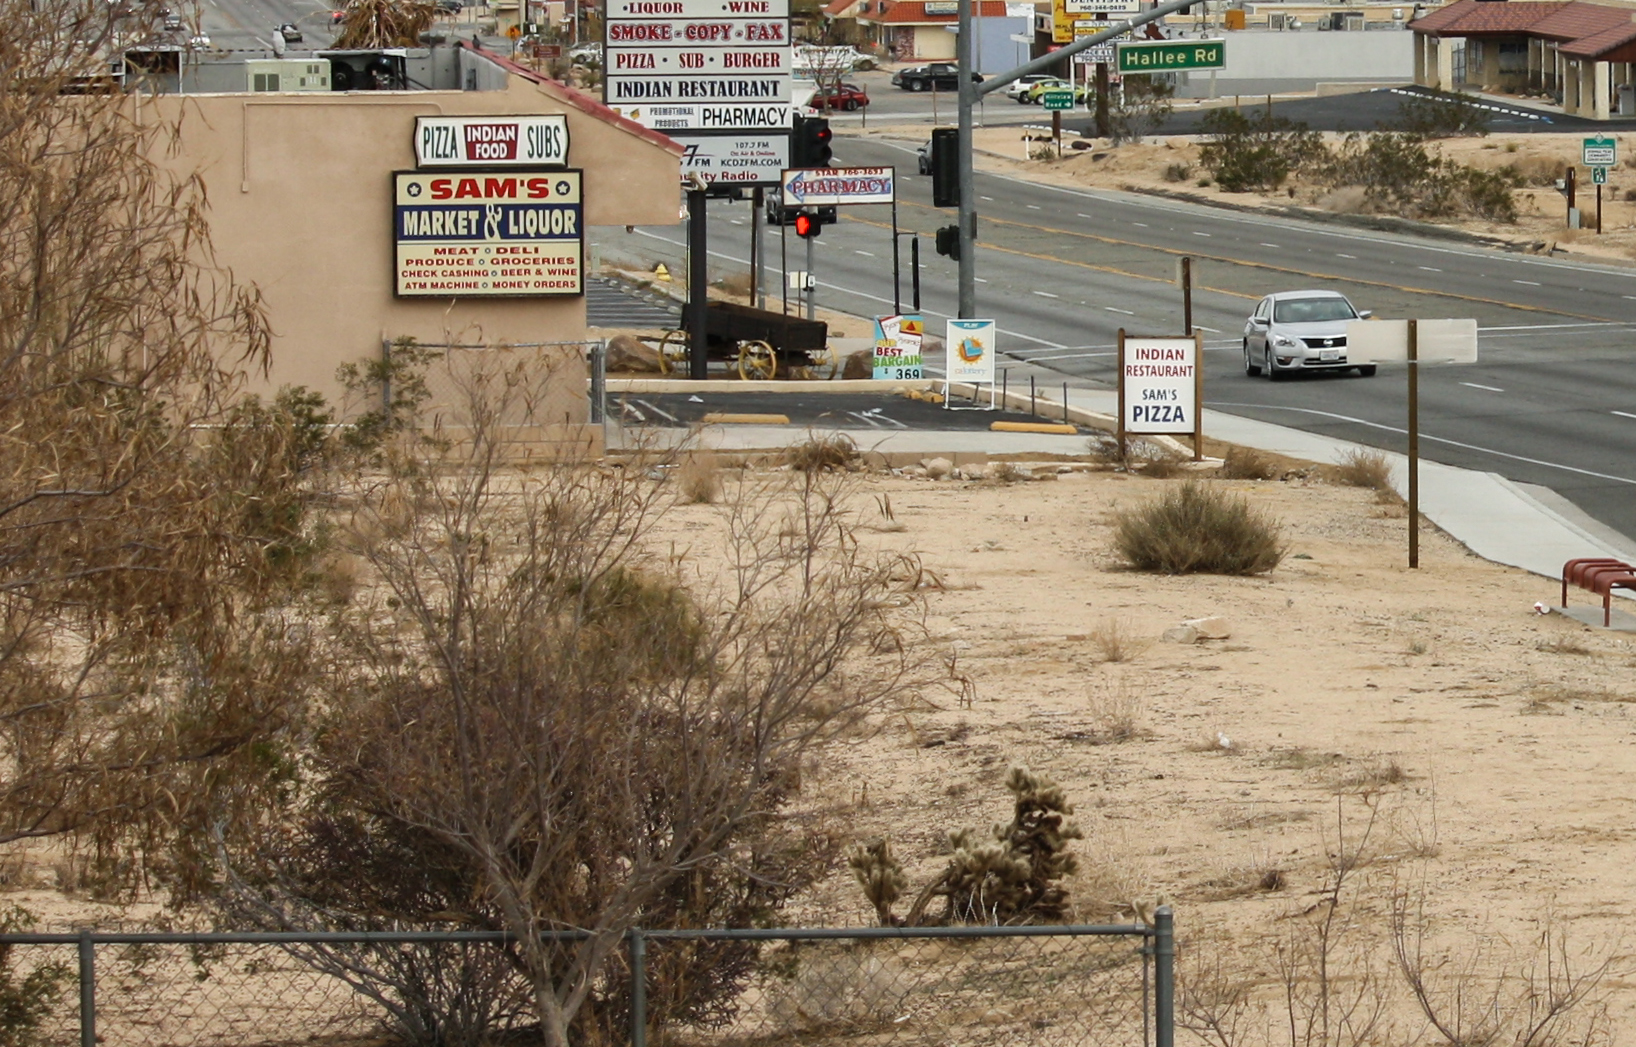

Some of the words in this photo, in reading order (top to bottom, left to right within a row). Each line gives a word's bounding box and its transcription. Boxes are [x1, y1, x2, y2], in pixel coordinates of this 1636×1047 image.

[629, 2, 683, 14] LIQUOR
[728, 2, 769, 12] WINE
[610, 24, 672, 41] SMOKE
[684, 24, 733, 40] COPY
[745, 23, 784, 40] FAX
[616, 54, 656, 69] PIZZA
[679, 53, 704, 68] SUB
[724, 52, 780, 68] BURGER
[1126, 51, 1186, 65] Hallee
[1195, 49, 1216, 62] Rd
[616, 81, 672, 98] INDIAN
[678, 80, 780, 97] RESTAURANT
[702, 108, 787, 126] PHARMACY
[467, 126, 515, 142] INDIAN
[424, 126, 458, 158] PIZZA
[528, 126, 561, 158] SUBS
[476, 143, 508, 158] FOOD
[722, 171, 758, 180] Radio
[430, 178, 549, 200] SAM'S
[792, 178, 890, 194] PHARMACY
[403, 210, 479, 236] MARKET
[484, 204, 502, 240] &
[508, 209, 576, 237] LIQUOR
[434, 247, 479, 255] MEAT
[406, 258, 475, 266] PRODUCE
[402, 270, 438, 278] CHECK
[501, 268, 531, 276] BEER
[535, 268, 542, 276] &
[547, 268, 577, 276] WINE
[534, 280, 576, 288] ORDERS
[876, 347, 902, 356] BEST
[1136, 348, 1184, 360] INDIAN
[873, 355, 923, 367] BARGAIN
[1126, 365, 1193, 377] RESTAURANT
[1142, 389, 1177, 400] SAM'S
[1132, 406, 1185, 422] PIZZA
